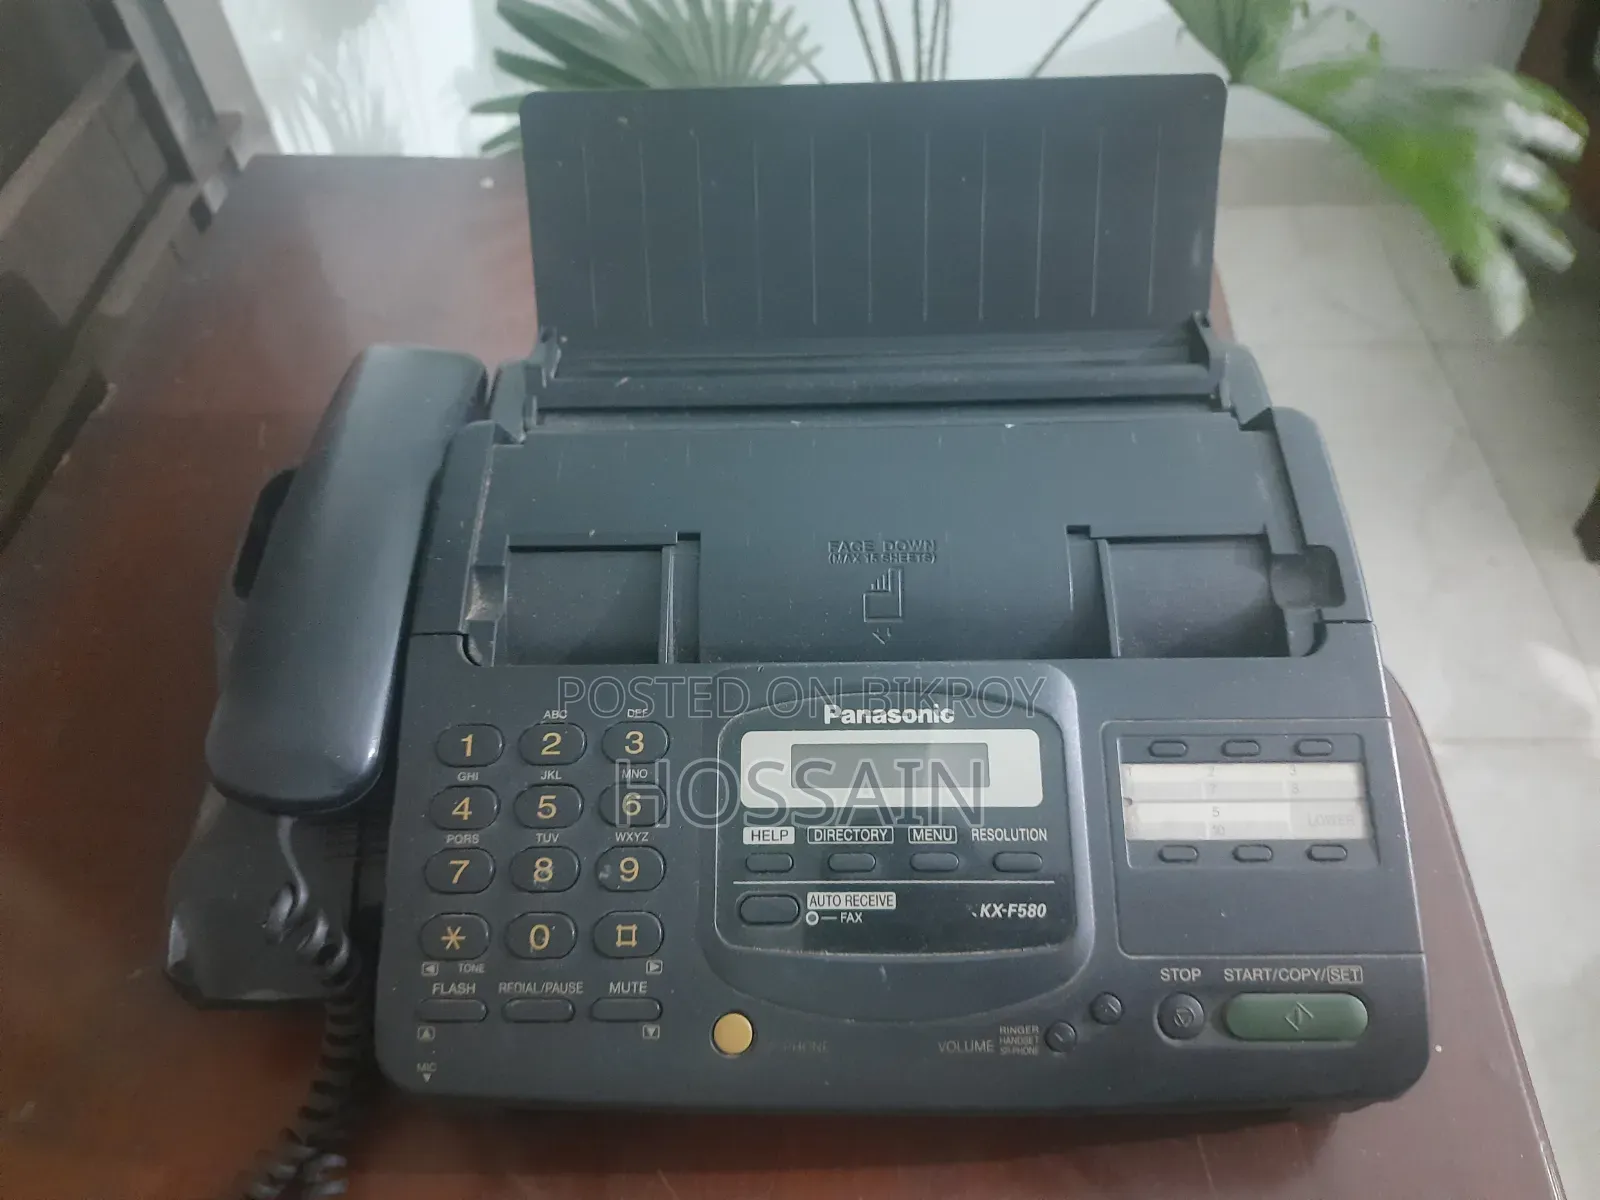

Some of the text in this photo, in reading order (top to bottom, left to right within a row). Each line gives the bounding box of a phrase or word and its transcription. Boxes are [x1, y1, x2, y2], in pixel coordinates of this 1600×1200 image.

[883, 540, 936, 552] DOWN
[824, 704, 955, 725] Panasonic
[460, 733, 474, 757] 1
[540, 732, 562, 755] 2
[624, 731, 645, 754] 3
[457, 771, 479, 782] GHI
[540, 769, 562, 780] JKL
[621, 768, 648, 779] MNO
[451, 796, 472, 820] 4
[536, 794, 557, 819] 5
[621, 792, 642, 816] 6
[1212, 806, 1221, 817] 5
[535, 833, 560, 843] TUV
[614, 832, 649, 842] WXYZ
[750, 829, 789, 843] HELP
[813, 828, 888, 842] DIRECTORY
[912, 828, 953, 842] MENU
[970, 827, 1048, 842] RESOLUTION
[449, 859, 471, 884] 7
[532, 857, 554, 882] 8
[619, 856, 640, 882] 9
[808, 893, 894, 907] AUTO RECEIVE
[979, 902, 1047, 919] KX-F580
[840, 912, 863, 924] FAX
[529, 924, 550, 950] 0
[458, 963, 485, 974] TONE
[1160, 967, 1201, 982] STOP
[432, 983, 476, 995] FLASH
[498, 981, 583, 995] REDIAL/PAUSE
[609, 981, 648, 994] MUTE
[999, 1024, 1040, 1034] RINGER
[938, 1040, 995, 1053] VOLUME
[417, 1062, 437, 1073] MIC
